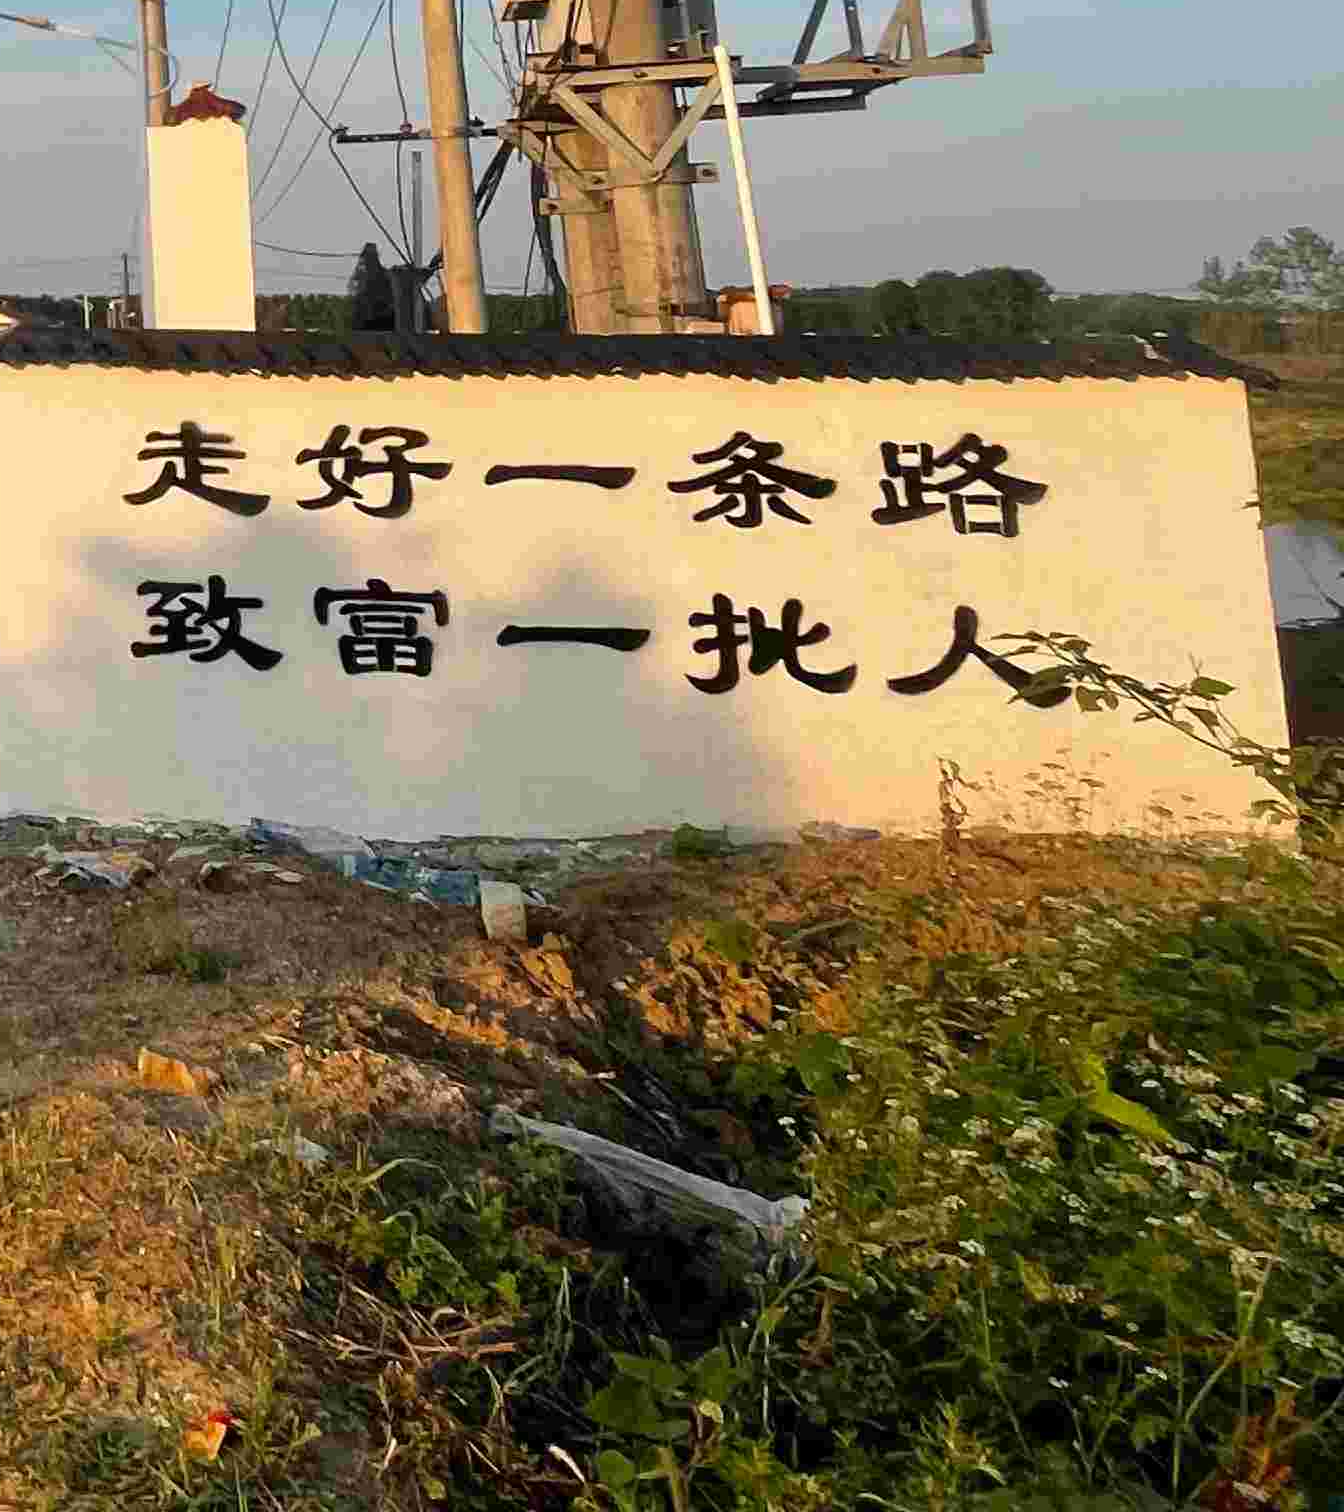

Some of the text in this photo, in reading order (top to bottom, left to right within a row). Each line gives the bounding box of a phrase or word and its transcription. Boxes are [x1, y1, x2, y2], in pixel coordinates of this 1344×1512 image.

[124, 421, 1049, 538] 走好一条路
[130, 575, 1072, 709] 致富一批人
